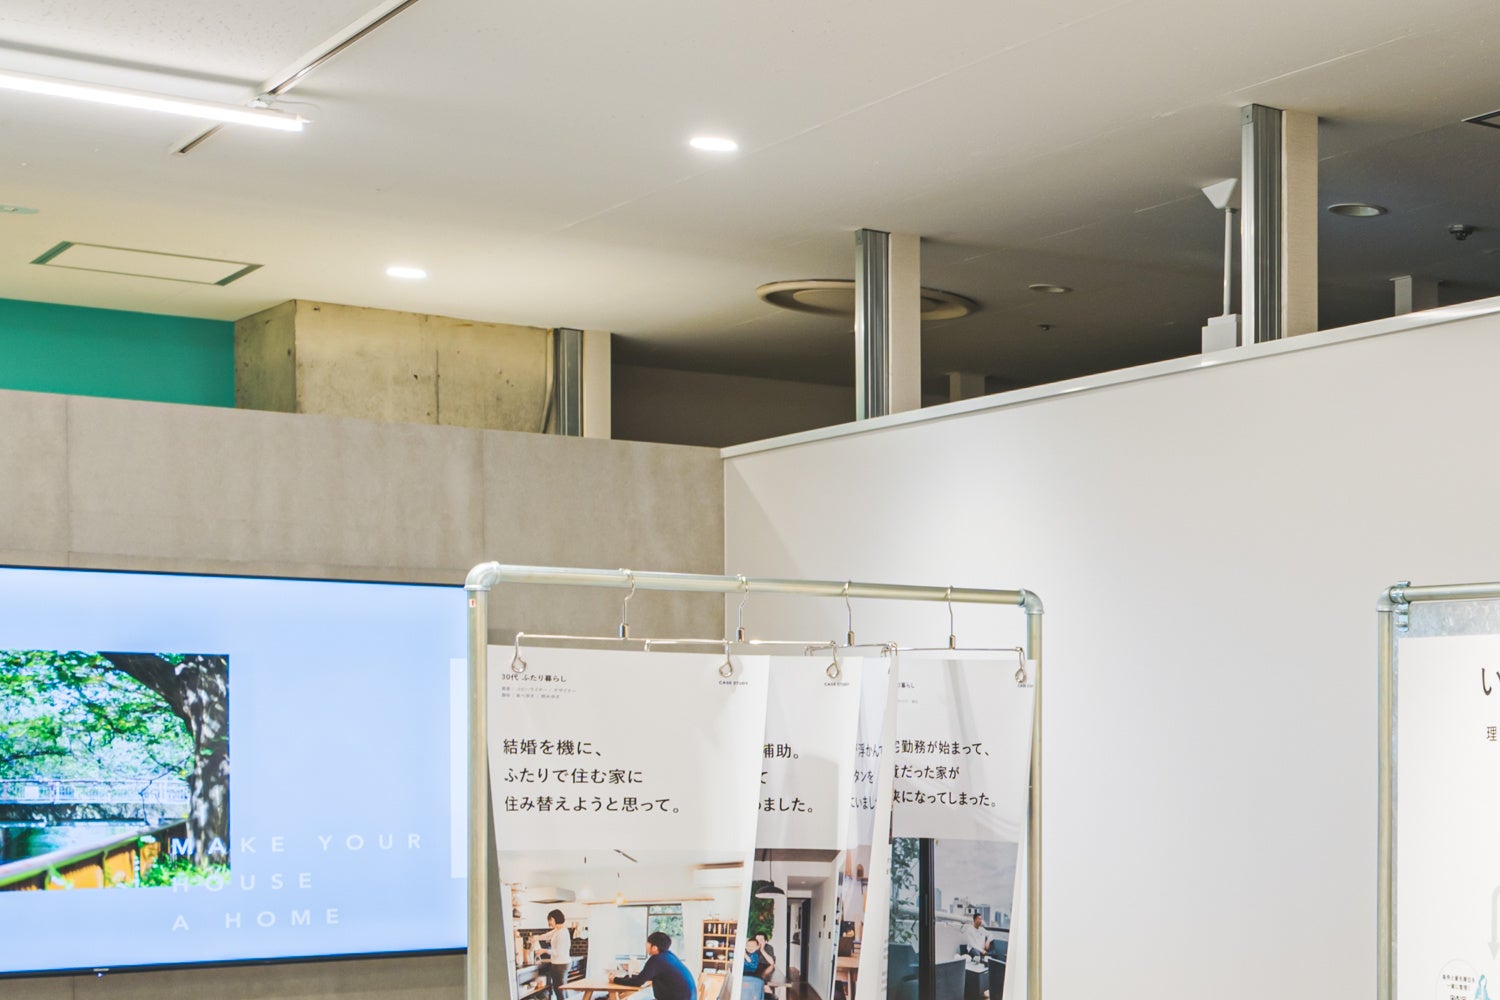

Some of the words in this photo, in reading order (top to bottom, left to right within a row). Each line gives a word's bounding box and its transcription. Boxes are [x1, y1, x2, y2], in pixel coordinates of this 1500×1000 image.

[503, 739, 602, 757] 結婚を機に、
[504, 768, 643, 784] ふたりで住む家に
[505, 796, 680, 813] 住み替えようと思って。
[758, 797, 813, 813] ました。
[171, 836, 286, 855] MAKE
[319, 832, 423, 852] YOUR
[172, 872, 313, 894] HOUSE
[172, 914, 190, 931] A
[225, 907, 341, 929] HOME
